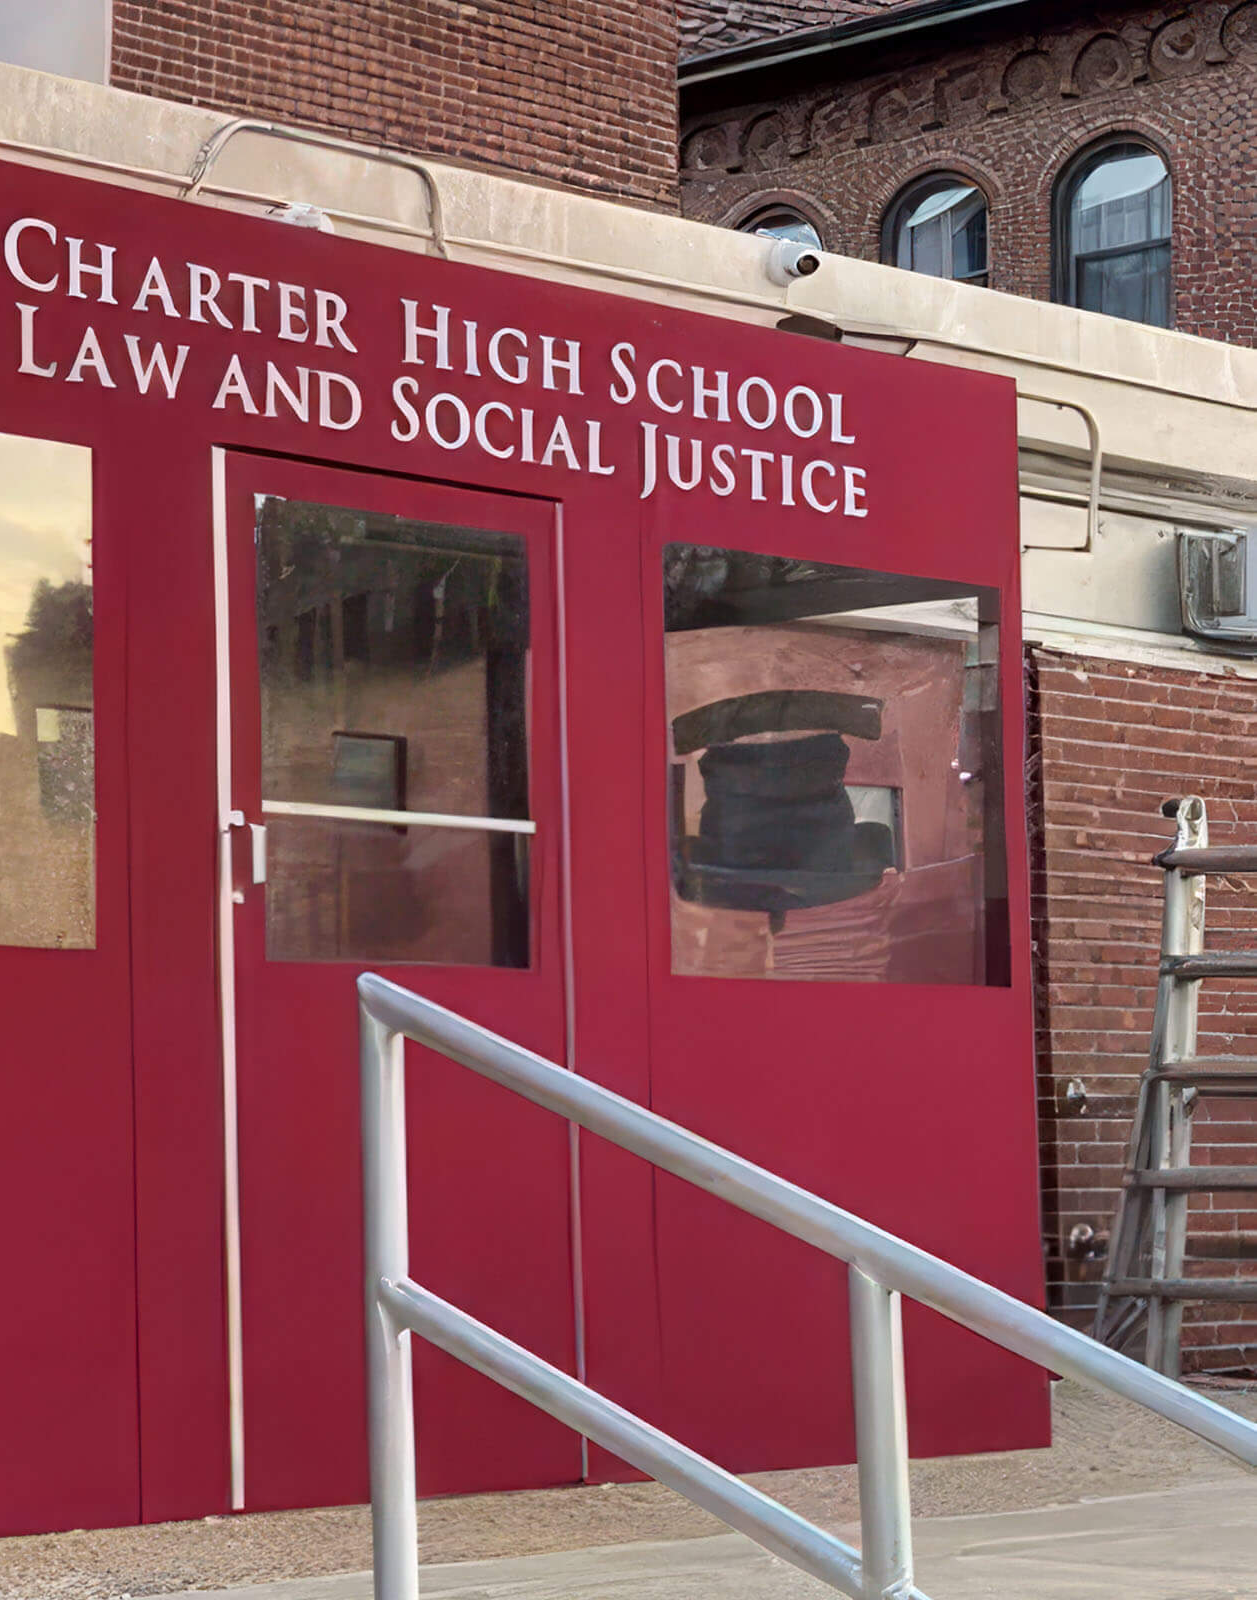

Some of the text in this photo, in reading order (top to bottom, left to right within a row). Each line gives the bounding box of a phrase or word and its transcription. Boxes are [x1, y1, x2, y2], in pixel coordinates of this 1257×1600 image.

[4, 217, 359, 354] CHARTER
[400, 298, 584, 396] HIGH
[609, 342, 856, 445] SCHOOL
[15, 301, 191, 399] LAW
[211, 353, 362, 431] AND
[390, 375, 616, 476] SOCIAL
[640, 421, 869, 518] JUSTICE
